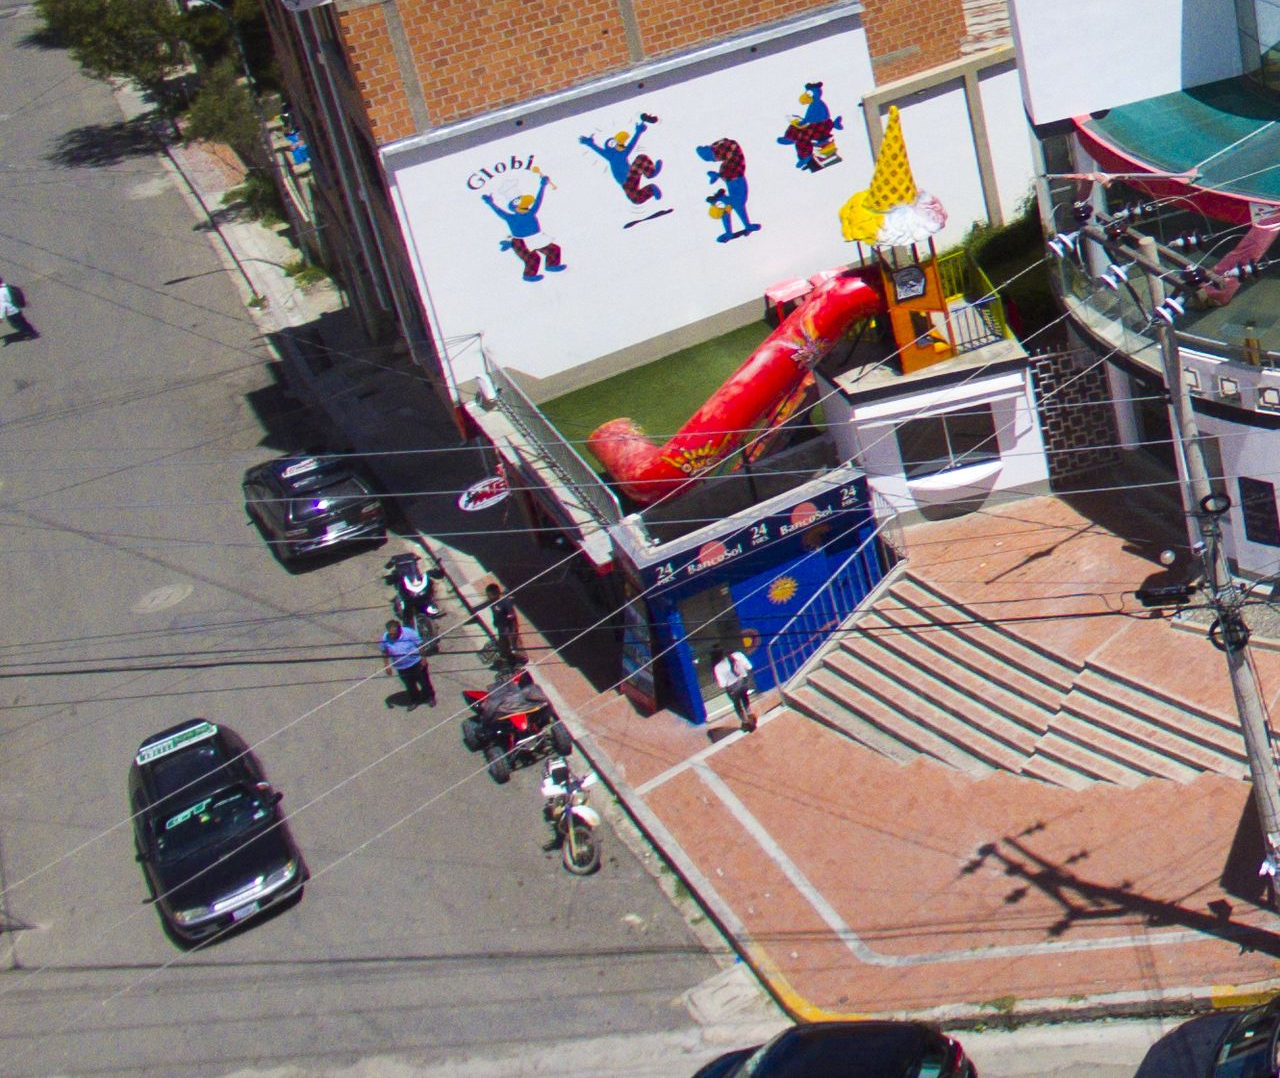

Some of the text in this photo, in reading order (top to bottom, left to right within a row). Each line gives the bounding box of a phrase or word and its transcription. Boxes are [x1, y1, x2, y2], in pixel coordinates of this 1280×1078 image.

[467, 155, 534, 190] Globi
[840, 485, 857, 501] 24
[751, 522, 768, 539] 24
[780, 505, 834, 537] BancoSol
[687, 543, 743, 575] BancoSol
[656, 563, 673, 580] 24
